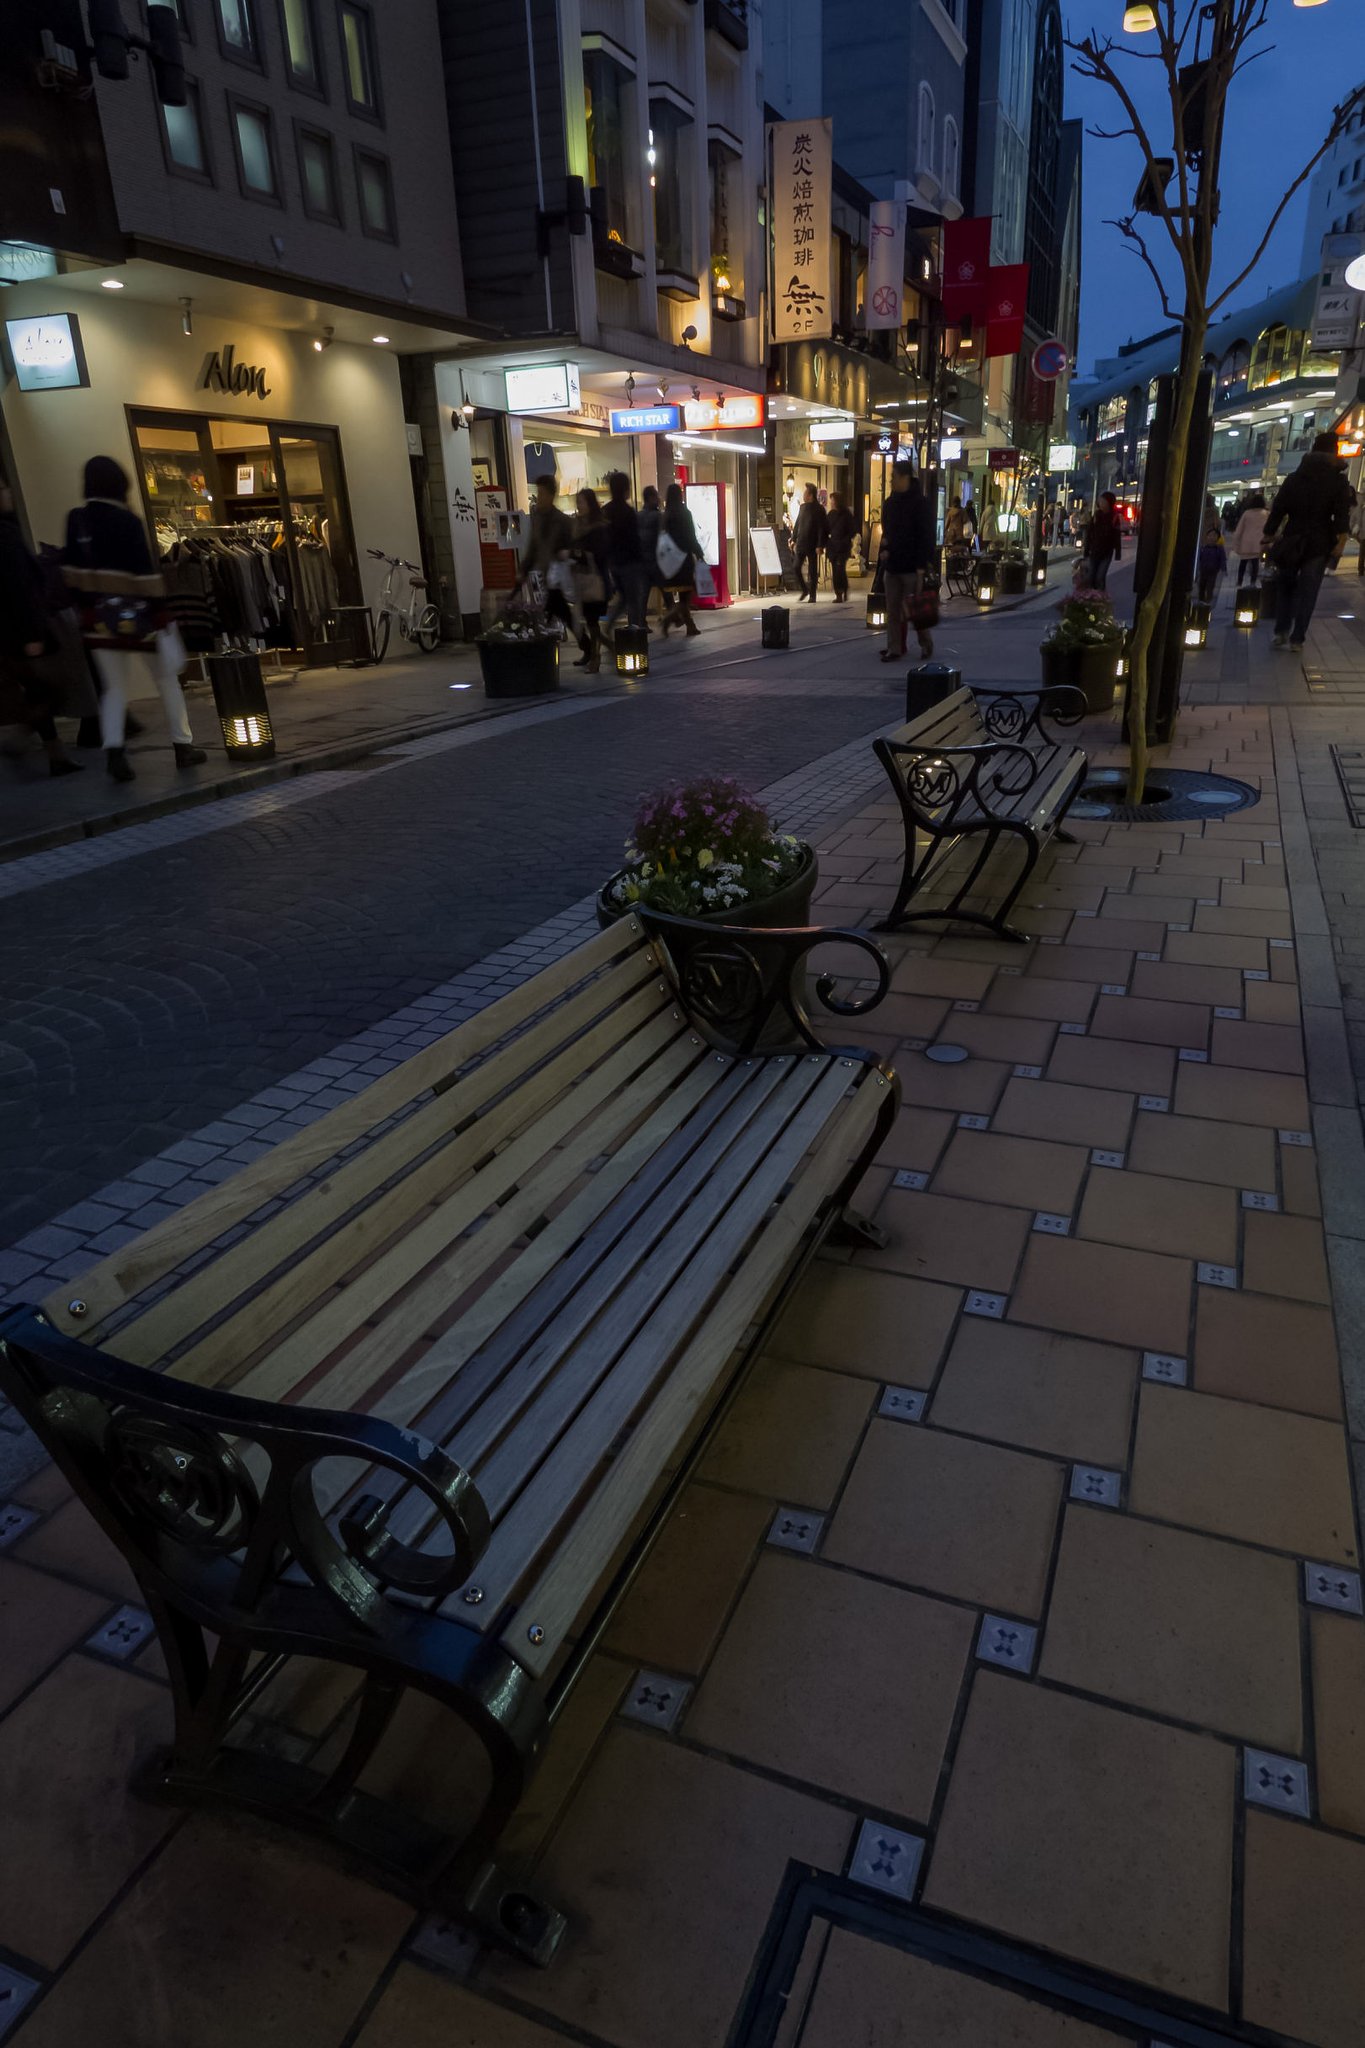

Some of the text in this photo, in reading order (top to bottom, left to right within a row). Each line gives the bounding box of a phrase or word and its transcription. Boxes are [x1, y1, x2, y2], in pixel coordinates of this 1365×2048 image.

[791, 134, 814, 266] 炭火焙煎珈琲
[782, 275, 825, 315] 無
[203, 344, 272, 400] Alon
[620, 414, 670, 428] RICH STAR
